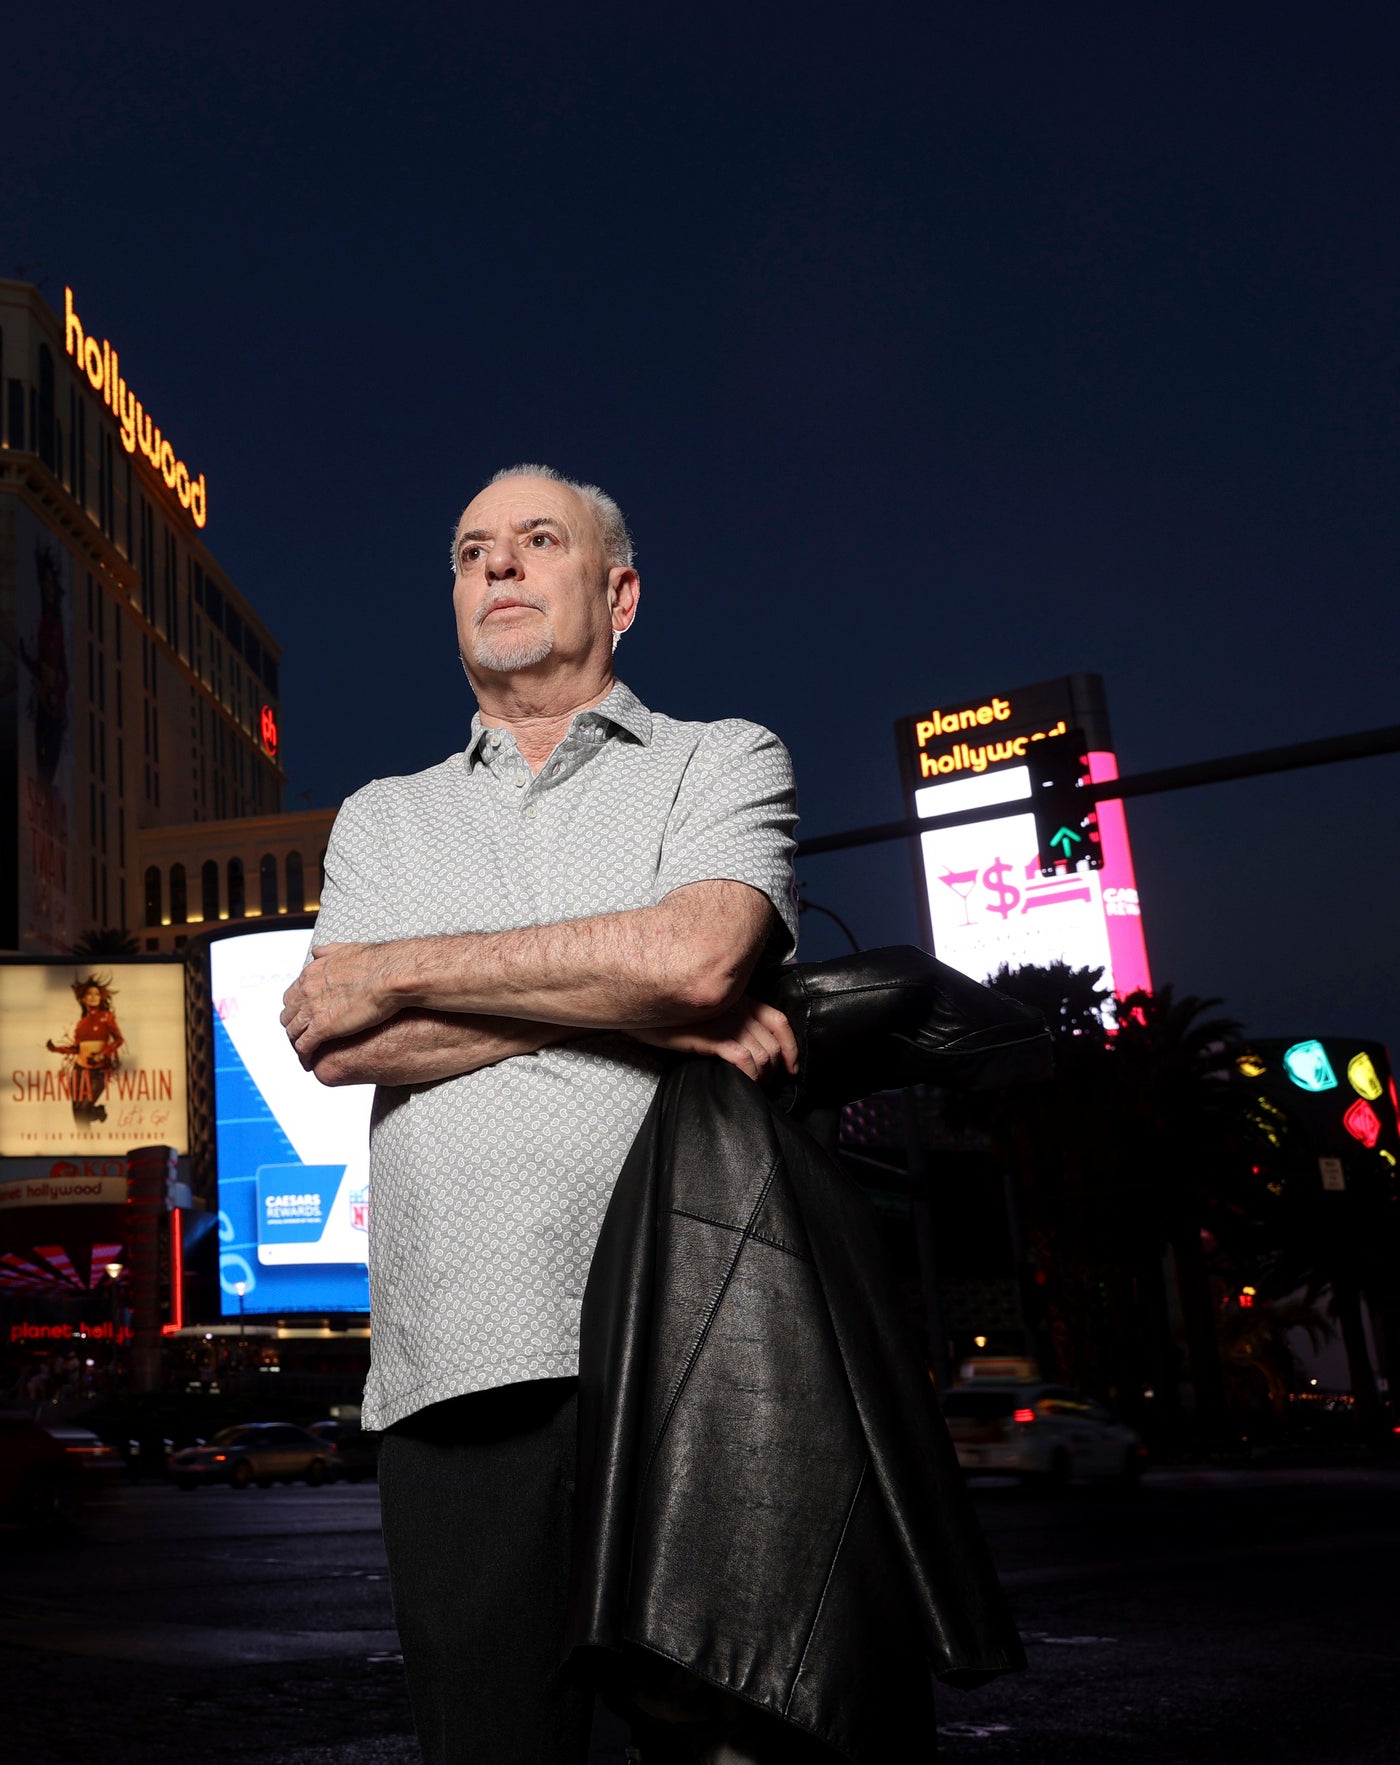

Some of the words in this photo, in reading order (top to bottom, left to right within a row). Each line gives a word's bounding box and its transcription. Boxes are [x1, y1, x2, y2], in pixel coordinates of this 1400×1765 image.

[64, 286, 207, 529] hollywood
[915, 697, 1012, 748] planet
[919, 720, 1068, 779] hollywo
[12, 1067, 94, 1103] SHANIA
[100, 1068, 173, 1102] TWAIN
[27, 1181, 103, 1201] hollywood
[11, 1320, 74, 1343] planet
